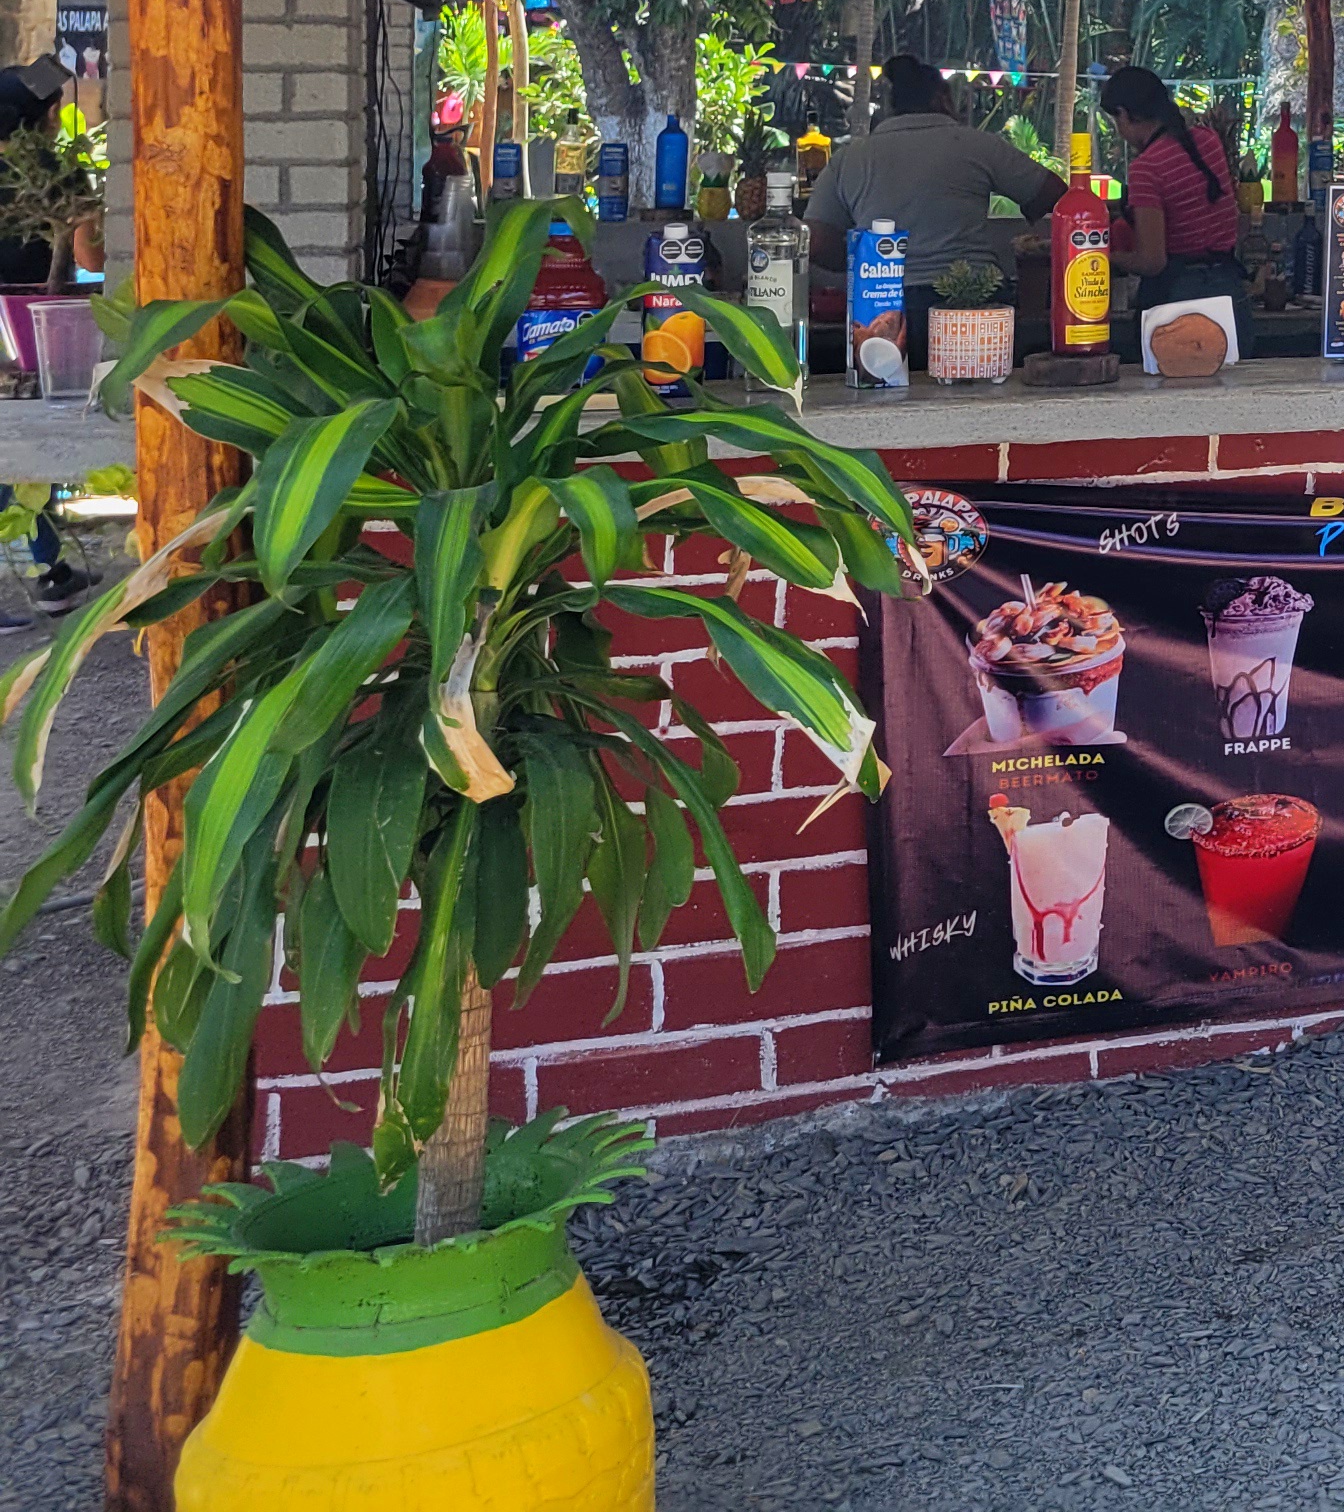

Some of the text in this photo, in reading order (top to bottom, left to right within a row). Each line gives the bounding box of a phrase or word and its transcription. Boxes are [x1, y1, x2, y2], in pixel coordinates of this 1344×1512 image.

[69, 10, 102, 32] PALAPA
[860, 262, 905, 279] Calahu
[1098, 511, 1181, 555] SHOTS
[901, 568, 955, 581] DRNKS
[1223, 738, 1292, 756] FRAPPE
[991, 752, 1106, 774] MICHELADA
[889, 910, 978, 962] WHISKY
[1208, 962, 1293, 983] VAMPIRO
[987, 988, 1124, 1015] PIÑA COLADA
